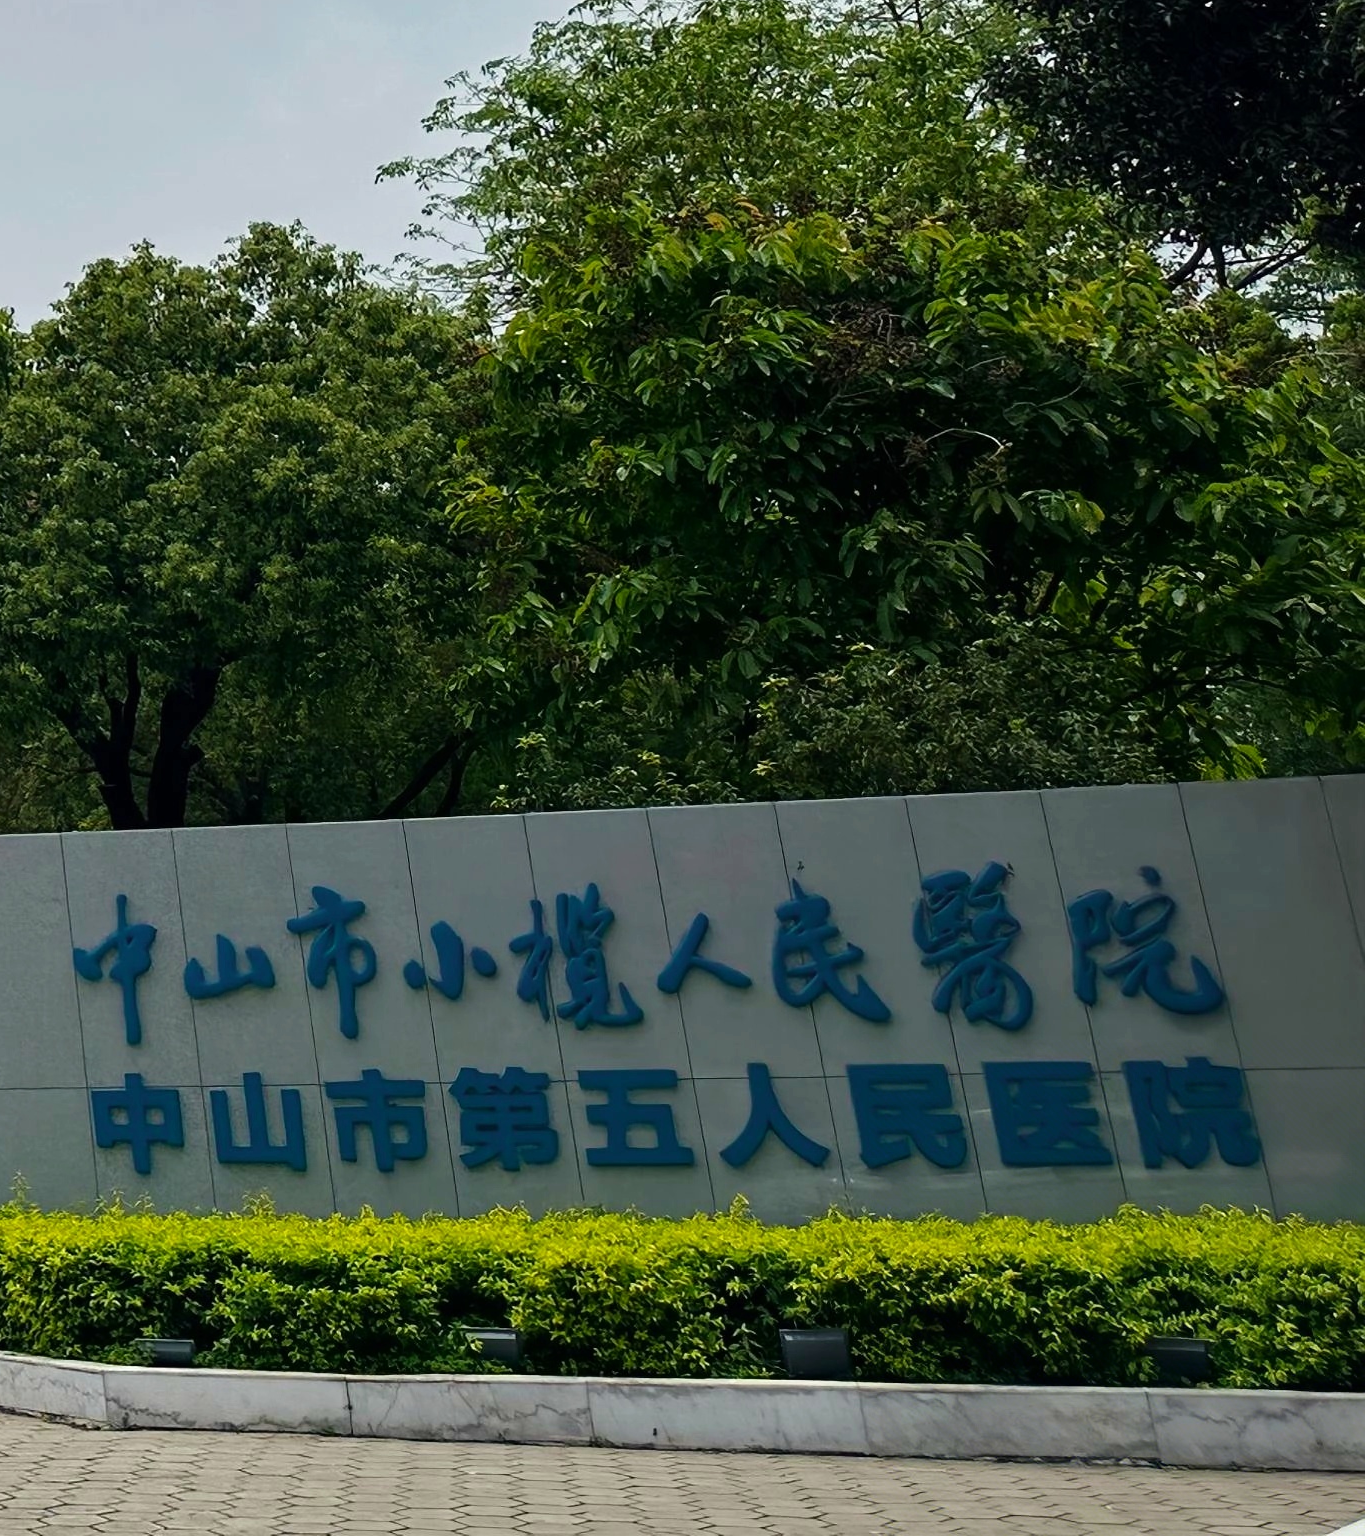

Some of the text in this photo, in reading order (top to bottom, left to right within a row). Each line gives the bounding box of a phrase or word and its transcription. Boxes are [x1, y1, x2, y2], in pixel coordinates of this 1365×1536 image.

[91, 1057, 1263, 1176] 中山市第五人民医院
